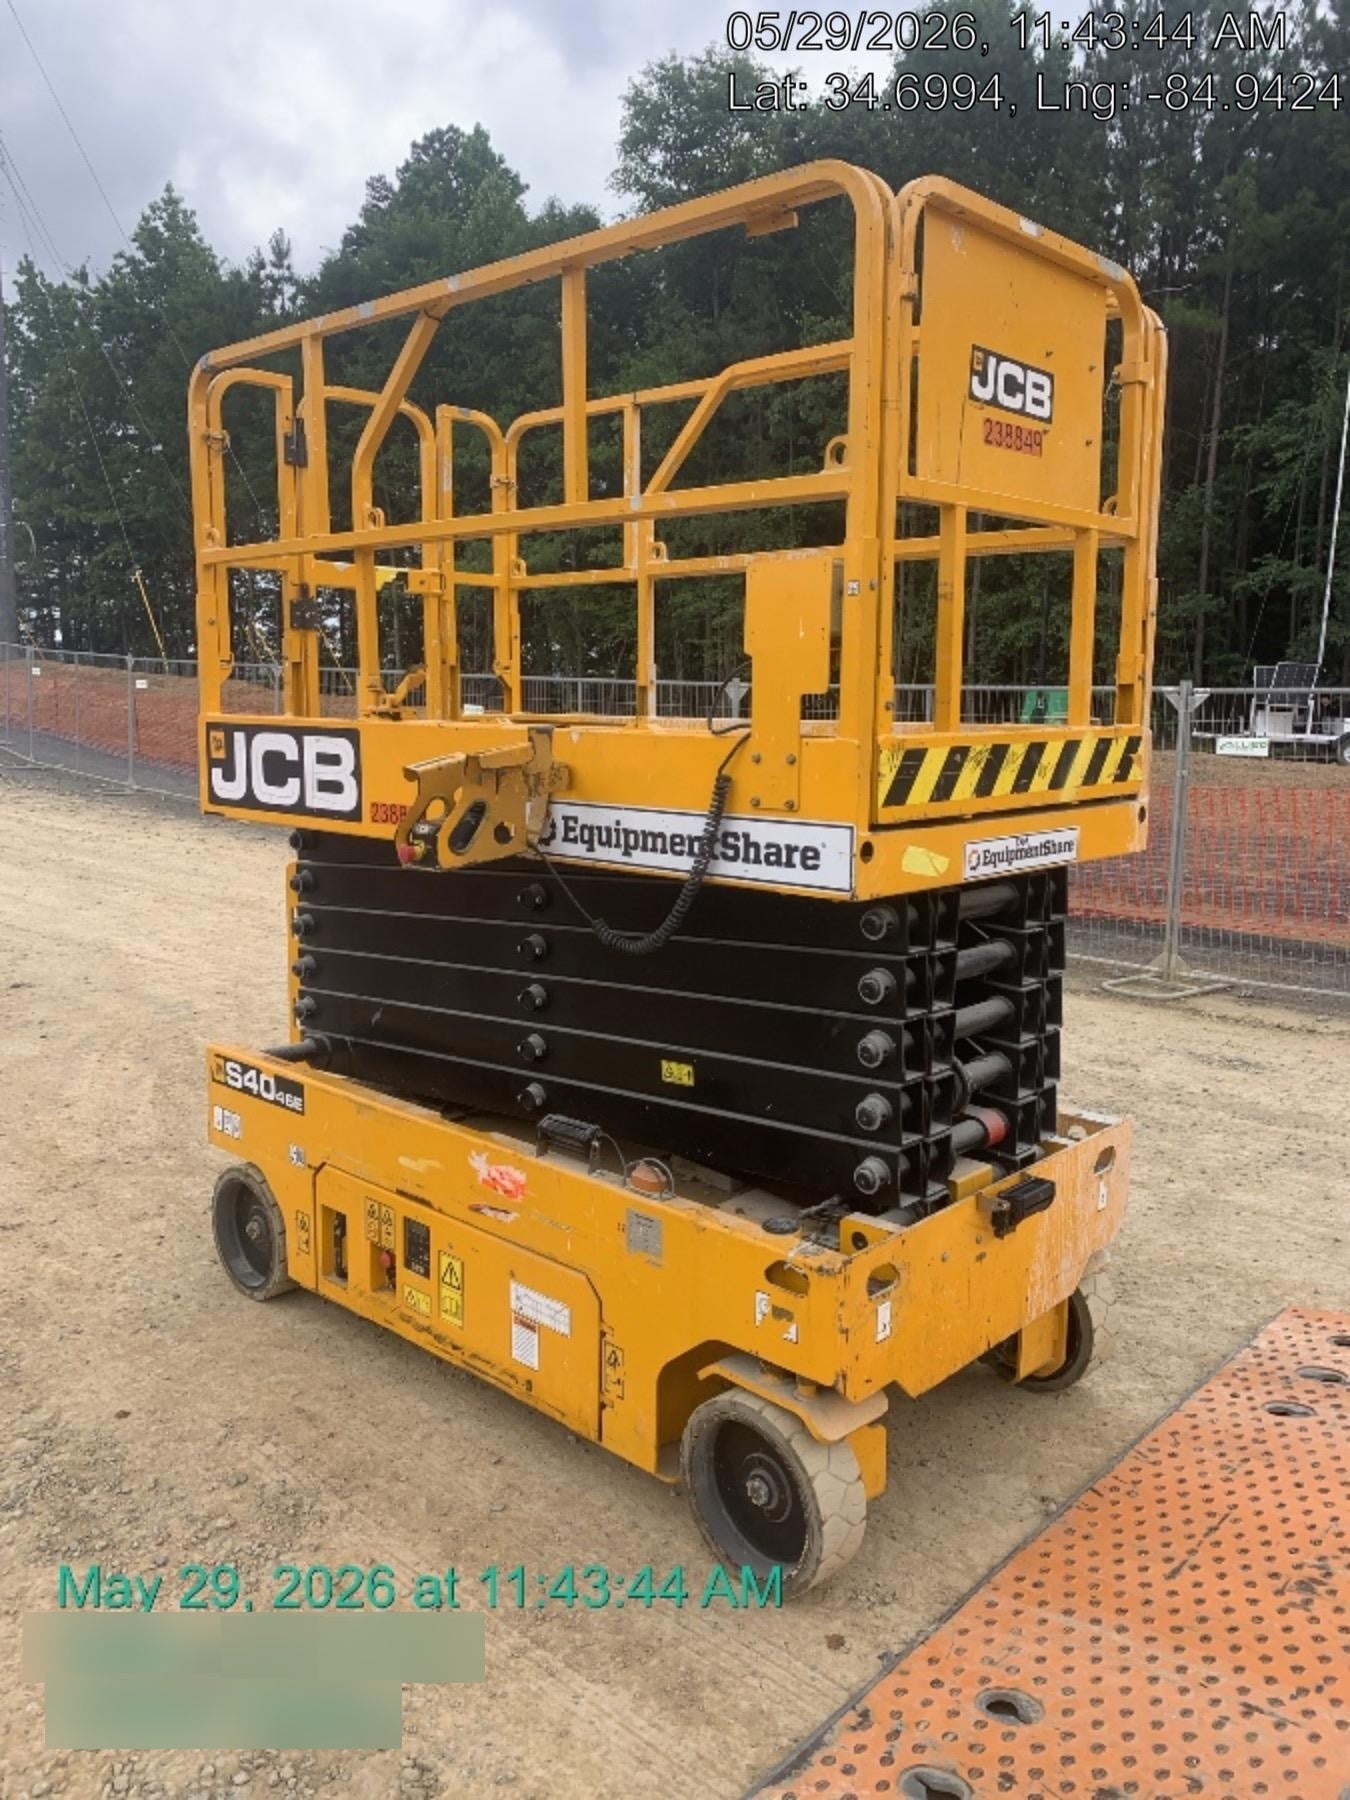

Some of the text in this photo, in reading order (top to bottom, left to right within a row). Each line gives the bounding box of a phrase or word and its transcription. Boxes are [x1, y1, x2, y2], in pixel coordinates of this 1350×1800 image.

[970, 355, 1052, 420] JCB
[983, 417, 1043, 457] 238849
[211, 731, 358, 811] JCB
[561, 815, 821, 871] EquipmenShare
